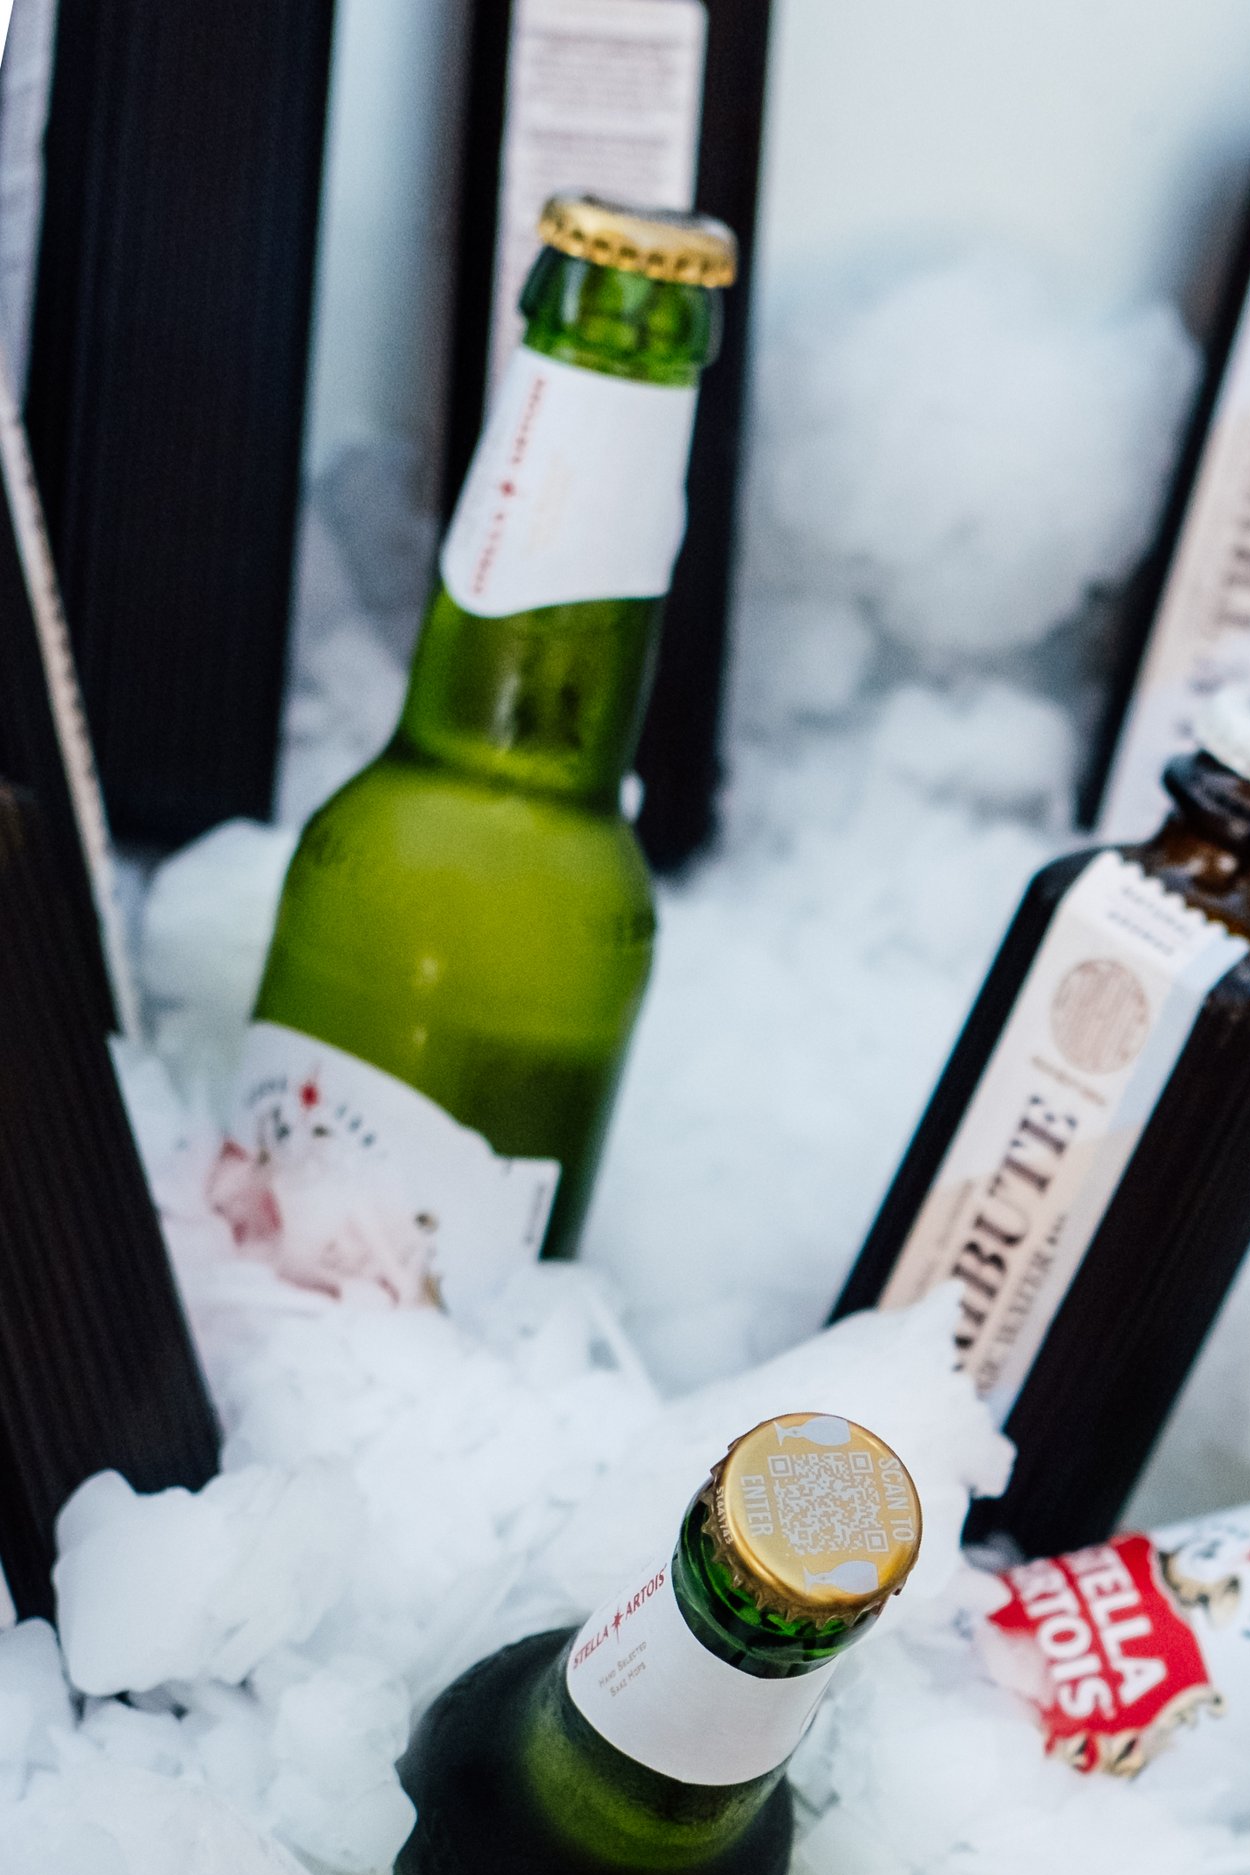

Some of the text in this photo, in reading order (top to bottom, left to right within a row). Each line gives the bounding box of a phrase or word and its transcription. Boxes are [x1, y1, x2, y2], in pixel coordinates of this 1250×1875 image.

[740, 1474, 774, 1537] ENTER
[878, 1456, 915, 1543] SCAN TO
[572, 1571, 666, 1669] STELLA ARTOIS
